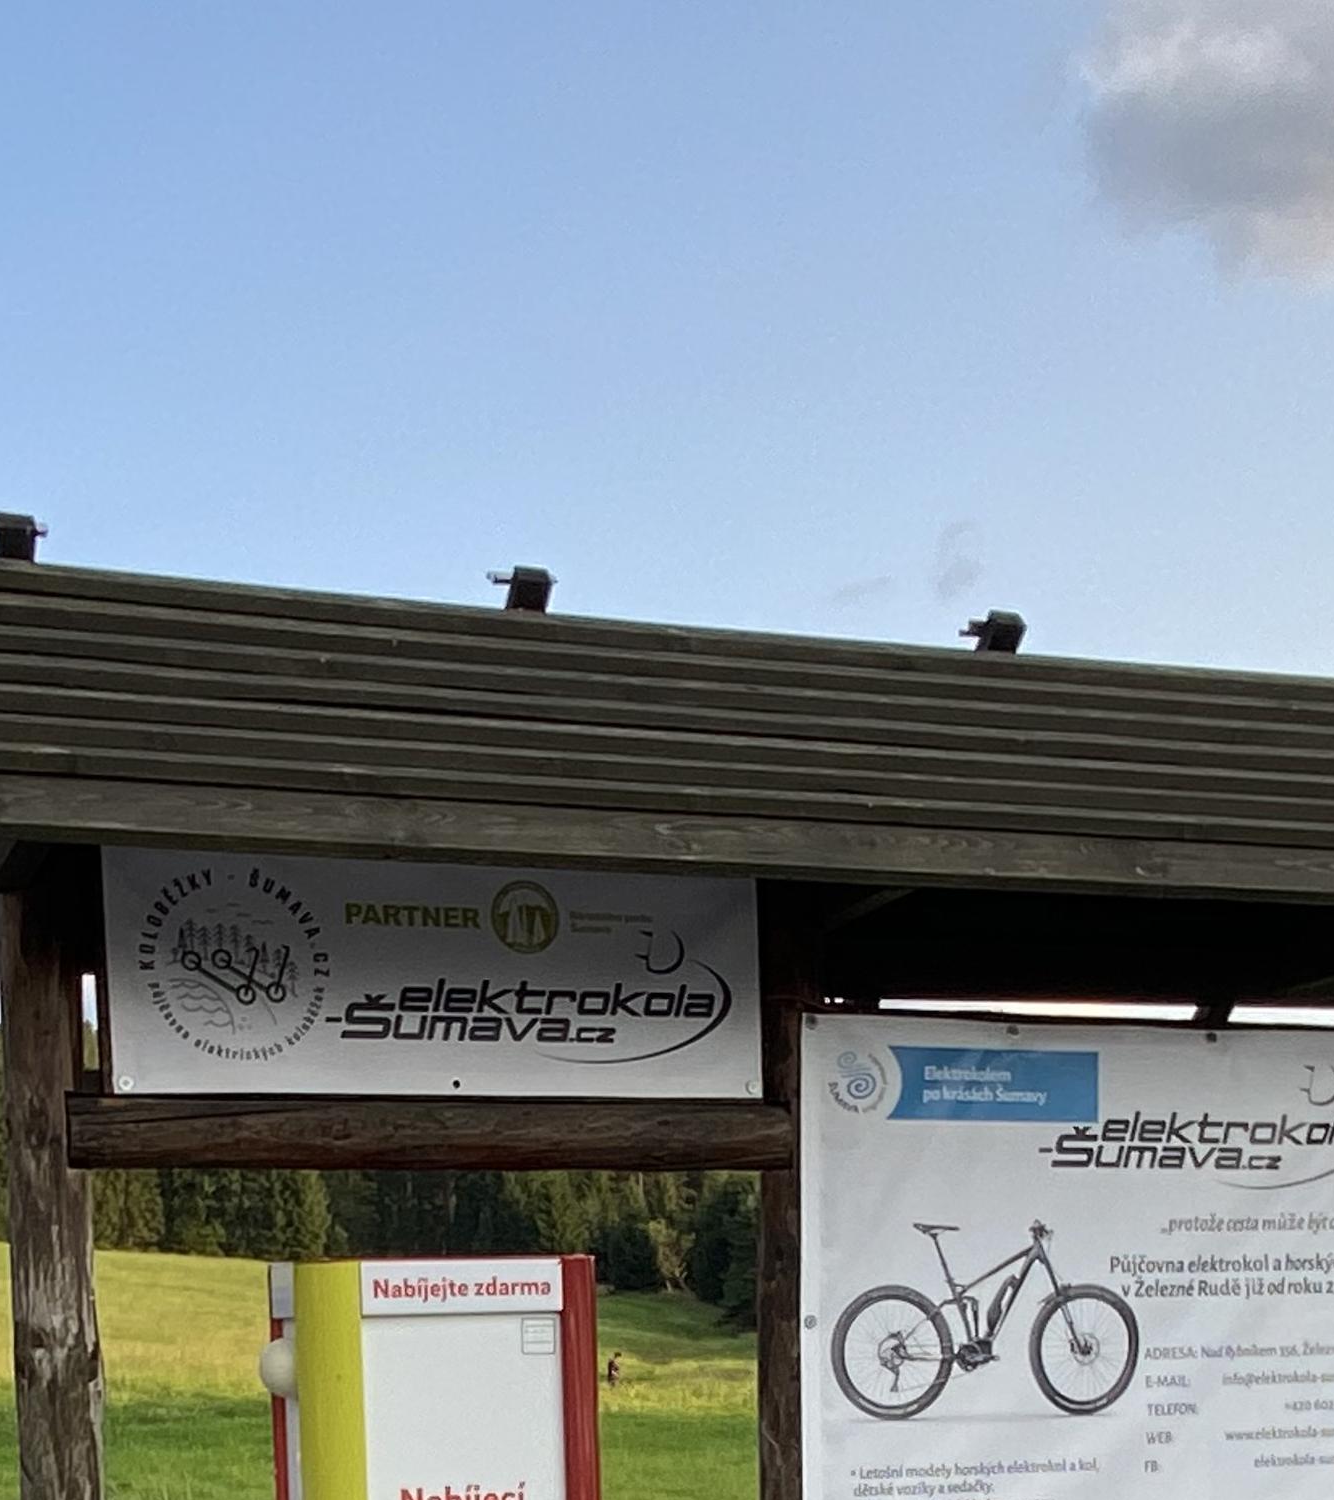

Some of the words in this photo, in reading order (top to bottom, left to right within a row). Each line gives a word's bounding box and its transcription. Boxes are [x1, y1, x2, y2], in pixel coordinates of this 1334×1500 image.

[344, 902, 481, 930] PARTNER
[398, 977, 714, 1019] elektrokola
[924, 1065, 1012, 1082] Elektrokolem
[922, 1088, 941, 1103] po
[995, 1085, 1048, 1106] Šumavy
[1226, 1217, 1259, 1232] cesta
[1261, 1212, 1305, 1231] může
[1109, 1254, 1185, 1277] Půjčovna
[1187, 1253, 1268, 1273] elektrokol
[1272, 1258, 1282, 1271] a
[372, 1276, 469, 1303] Nabíjejte
[474, 1276, 552, 1298] zdarma
[1120, 1283, 1132, 1297] v
[1134, 1276, 1195, 1298] Železné
[1197, 1278, 1242, 1297] Rudě
[1245, 1278, 1264, 1300] již
[1266, 1277, 1286, 1295] od
[1287, 1277, 1323, 1295] roku
[1143, 1346, 1198, 1361] ADRESA:
[1145, 1374, 1192, 1389] E-MAIL:
[1147, 1402, 1200, 1417] TELEFON:
[859, 1464, 904, 1479] Letošní
[905, 1464, 952, 1480] modely
[954, 1461, 1006, 1478] horských
[1069, 1462, 1077, 1472] a
[853, 1483, 894, 1498] dětské
[895, 1481, 936, 1498] vozíky
[938, 1484, 946, 1495] a
